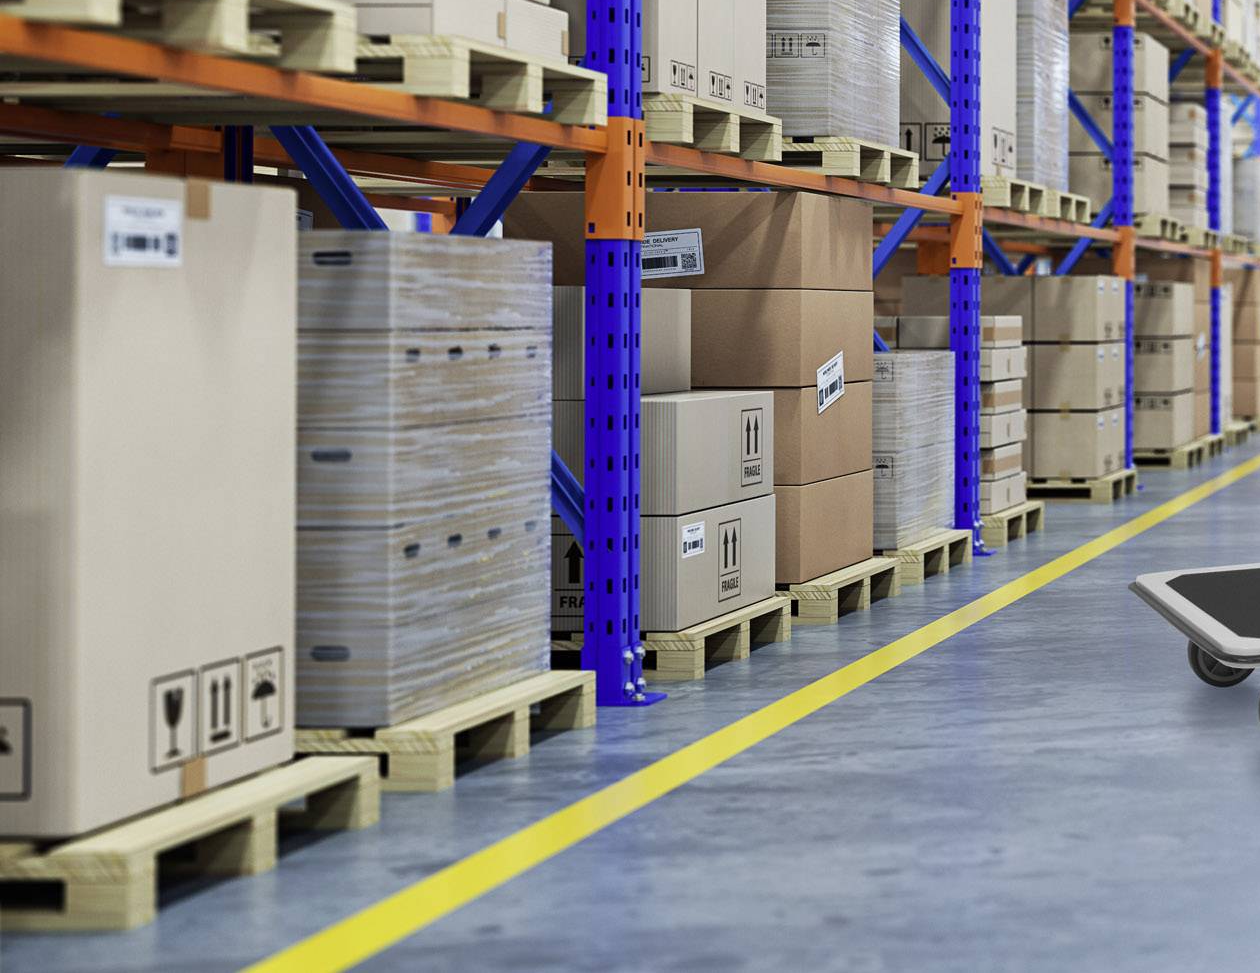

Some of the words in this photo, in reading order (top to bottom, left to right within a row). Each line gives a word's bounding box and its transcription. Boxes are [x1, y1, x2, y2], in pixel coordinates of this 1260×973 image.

[652, 236, 679, 244] DELIVERY
[743, 464, 761, 479] FRAGILE
[721, 576, 739, 593] FRAGILE
[560, 596, 585, 608] FRA
